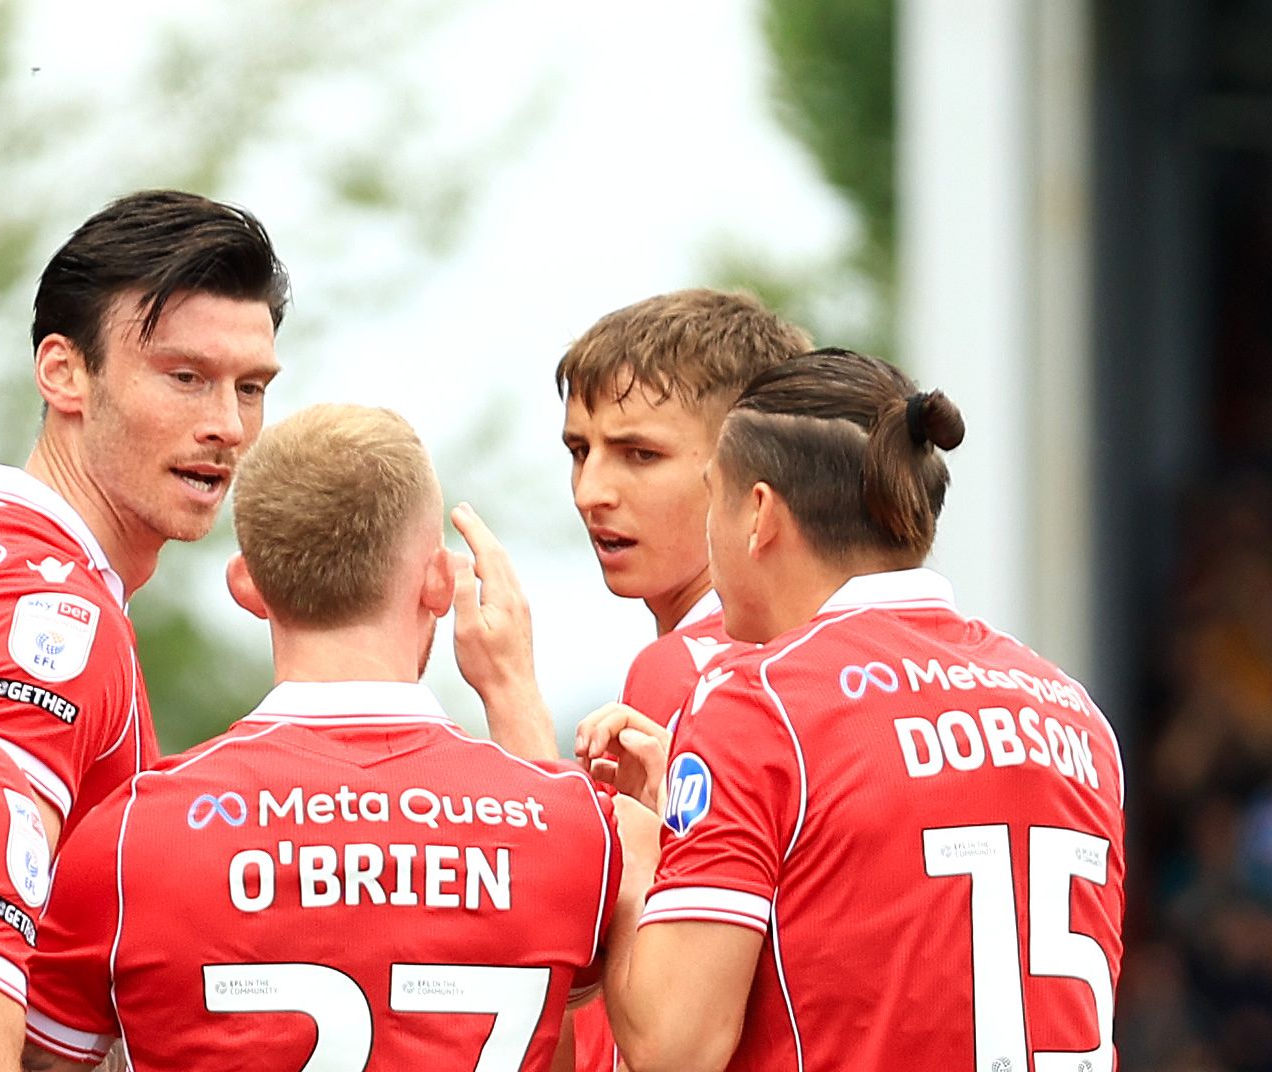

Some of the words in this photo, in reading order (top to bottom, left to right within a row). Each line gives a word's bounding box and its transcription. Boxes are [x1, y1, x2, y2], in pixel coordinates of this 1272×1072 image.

[60, 602, 89, 622] bet
[33, 654, 56, 671] EFL
[901, 658, 1018, 692] Meta
[1008, 668, 1090, 717] Quest
[893, 705, 1100, 790] DOBSON
[665, 758, 706, 834] hp
[258, 785, 390, 827] Meta
[399, 787, 548, 831] Quest
[228, 840, 511, 913] O'BRIEN
[229, 979, 243, 987] EFL
[244, 979, 254, 987] IN
[255, 979, 270, 987] THE
[229, 986, 278, 995] COMMUNITY
[417, 980, 431, 988] EFL
[431, 980, 441, 988] IN
[442, 980, 456, 988] THE
[417, 987, 465, 996] COMMUNITY
